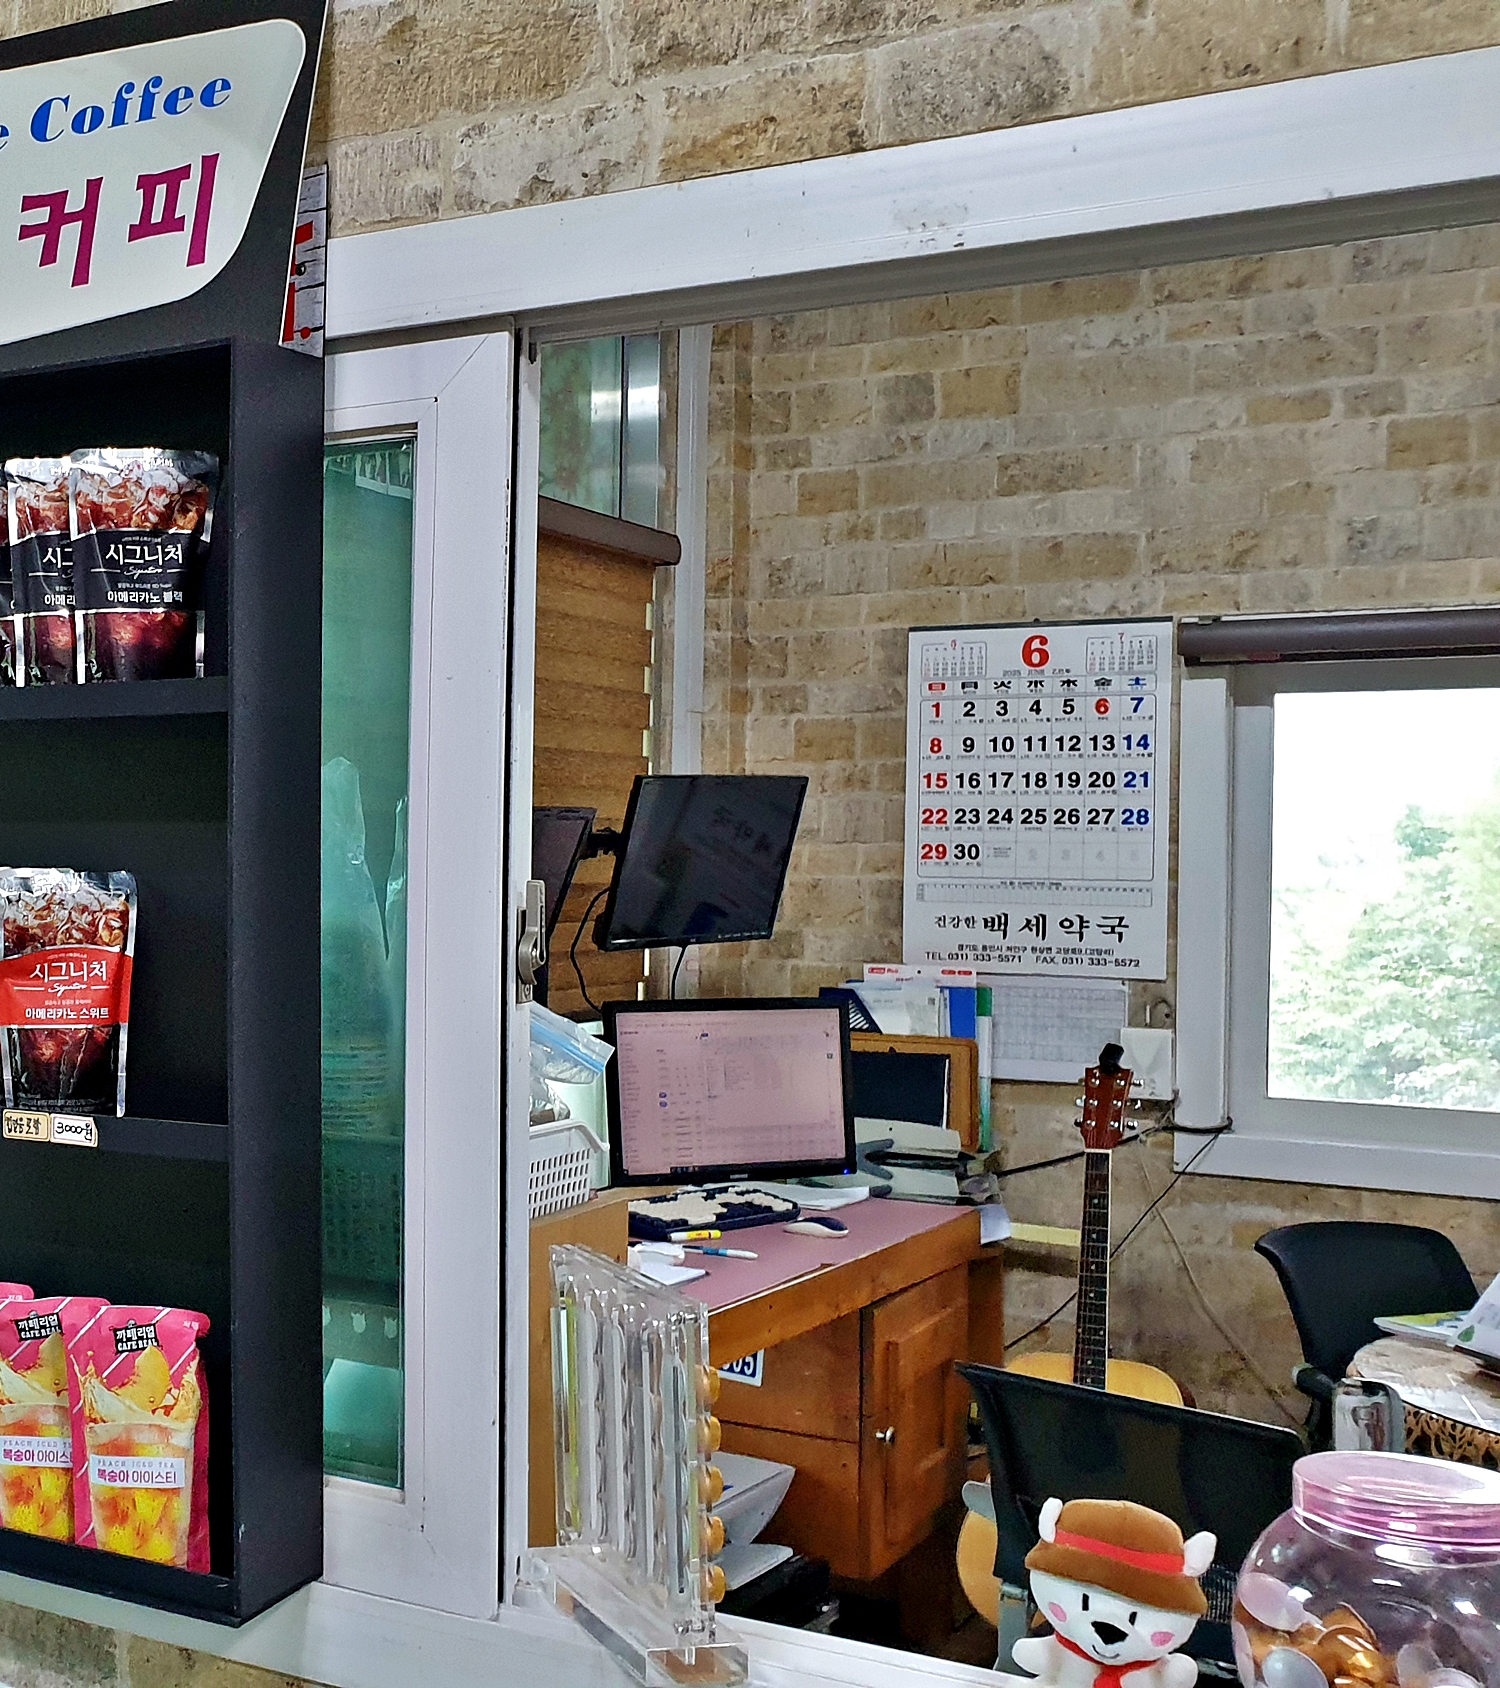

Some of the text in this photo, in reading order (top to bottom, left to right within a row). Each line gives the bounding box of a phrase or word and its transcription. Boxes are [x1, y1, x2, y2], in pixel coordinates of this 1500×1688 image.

[29, 75, 233, 143] Coffee
[18, 153, 221, 288] 커피
[106, 544, 182, 565] 시그니처
[44, 594, 76, 606] 아메리
[108, 591, 160, 603] 아메리카노
[1021, 635, 1050, 668] 6
[932, 697, 1144, 718] 1 2 3 4 5 6 7
[930, 734, 1149, 753] 8 9 10 11 12 13 14
[923, 771, 1148, 788] 15 16 17 18 19 20 21
[922, 809, 1149, 825] 22 23 24 25 26 27 28
[921, 844, 946, 859] 29
[954, 844, 979, 860] 30
[934, 912, 1130, 944] 건강한 백세약국
[29, 960, 106, 983] 시그니처
[26, 1008, 109, 1019] 아메리카노 스위트
[21, 1330, 40, 1339] CAFE
[118, 1341, 138, 1351] CAFE
[3, 1449, 35, 1462] 복숭아
[97, 1459, 126, 1467] PEACH
[97, 1469, 176, 1484] 복숭아 아이스티
